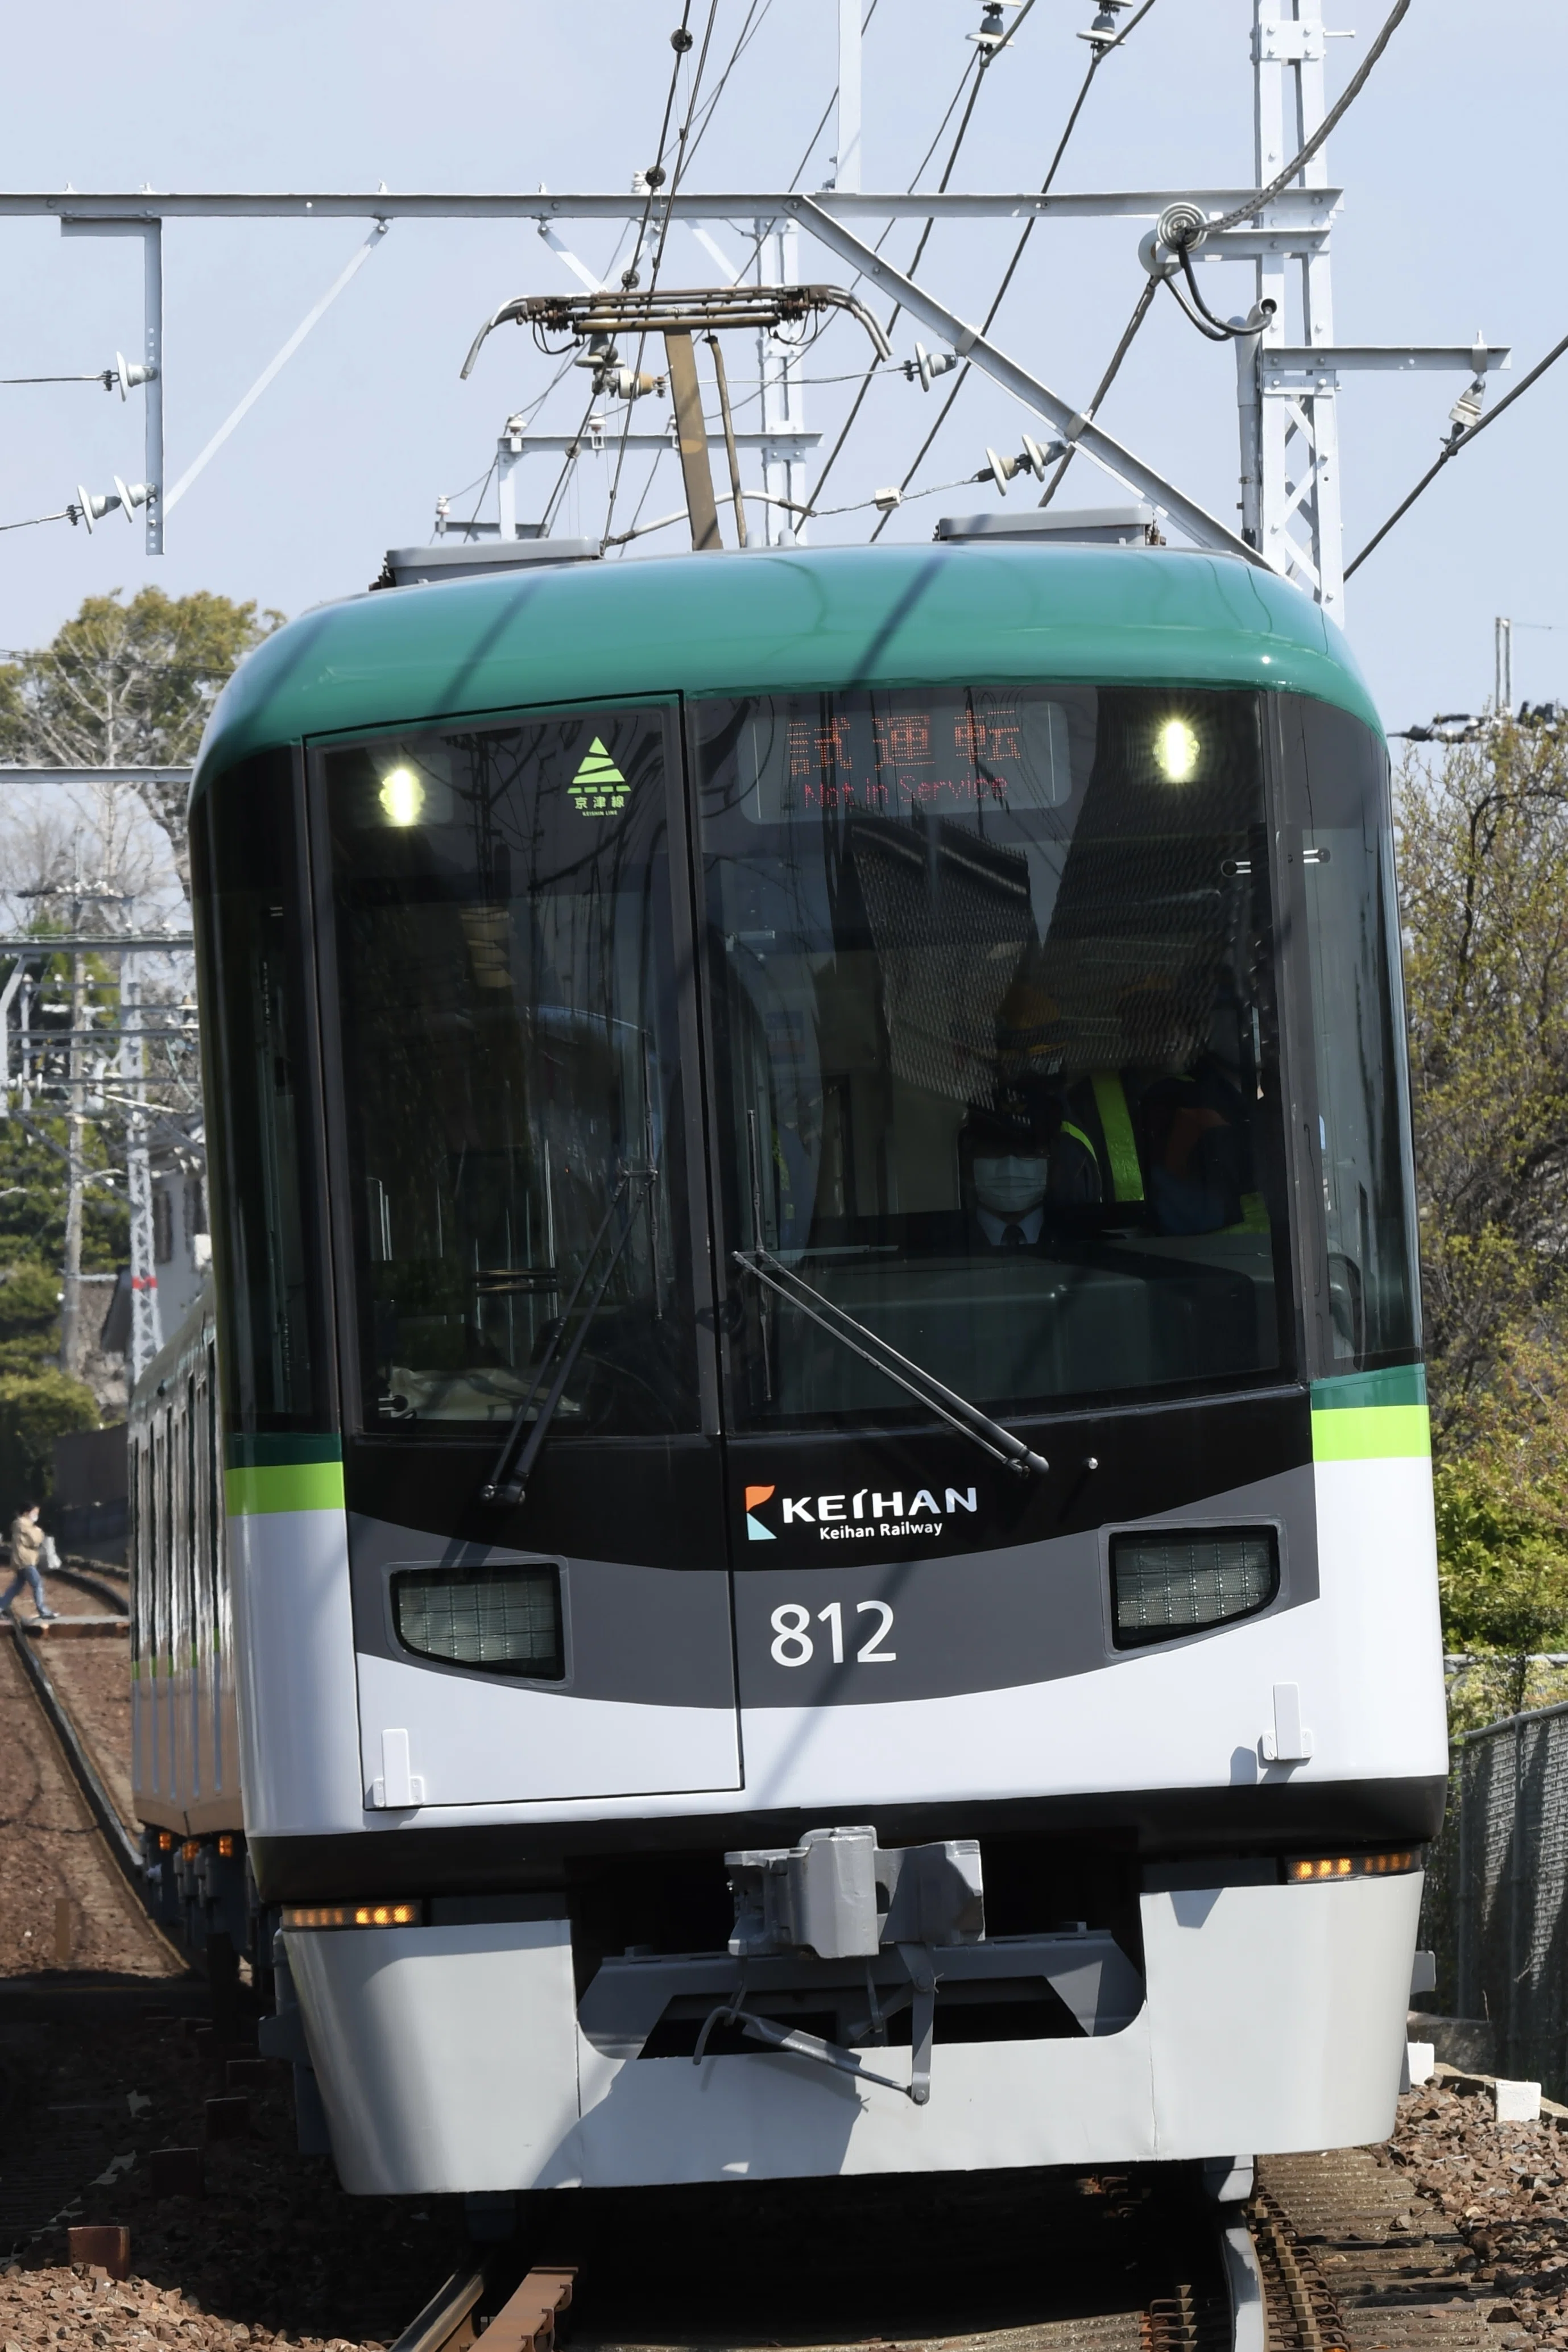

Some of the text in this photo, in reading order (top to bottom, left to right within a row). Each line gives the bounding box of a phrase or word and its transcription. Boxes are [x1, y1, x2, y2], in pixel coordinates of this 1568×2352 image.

[786, 709, 1021, 776] 試運転
[574, 795, 624, 809] 京津線
[804, 771, 1008, 808] Not in Service
[782, 1487, 978, 1523] KEIHAN
[820, 1521, 943, 1540] Keihan Railway
[770, 1600, 897, 1667] 812
